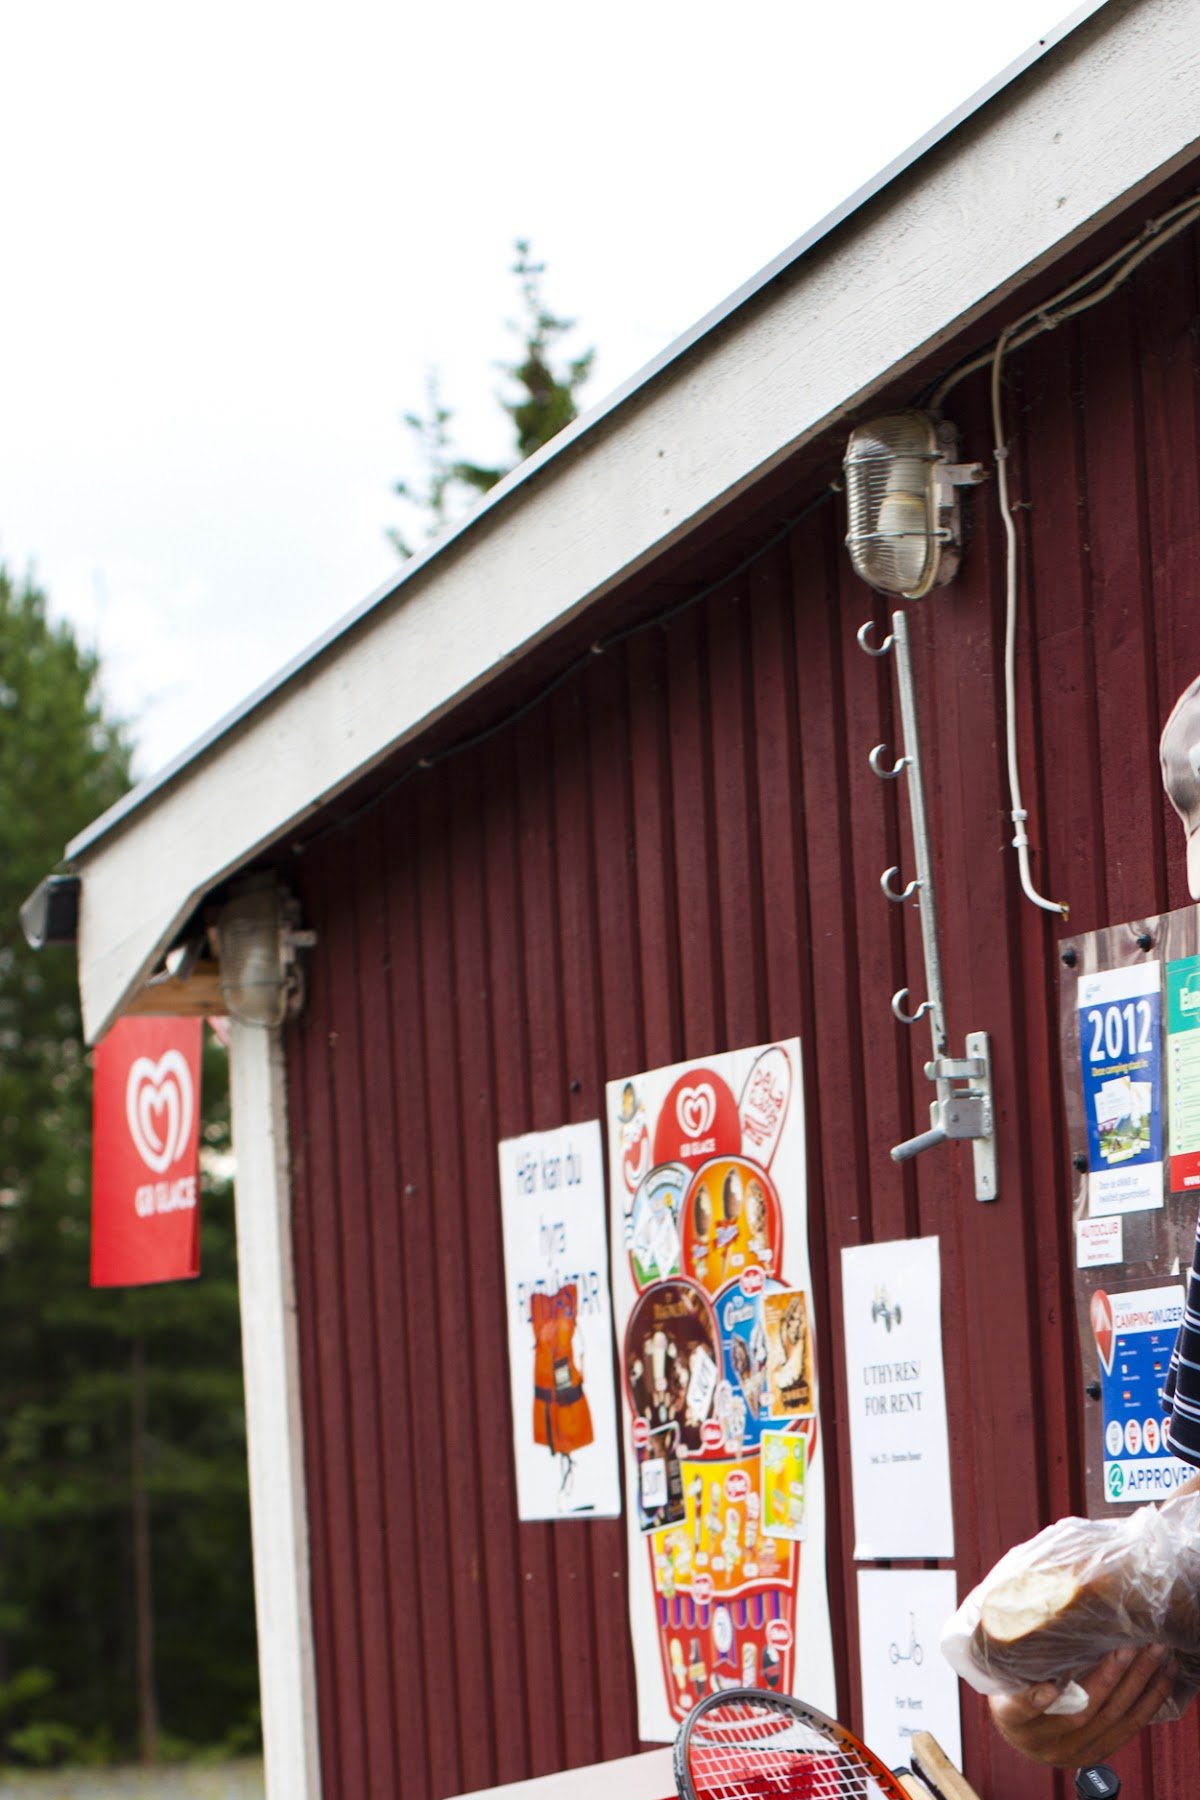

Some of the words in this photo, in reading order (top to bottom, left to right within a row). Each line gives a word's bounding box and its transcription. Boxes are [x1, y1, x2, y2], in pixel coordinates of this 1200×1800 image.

[1087, 1000, 1153, 1062] 2012
[541, 1147, 563, 1191] kan
[565, 1140, 583, 1186] du
[865, 1395, 888, 1417] FOR
[890, 1391, 923, 1414] RENT
